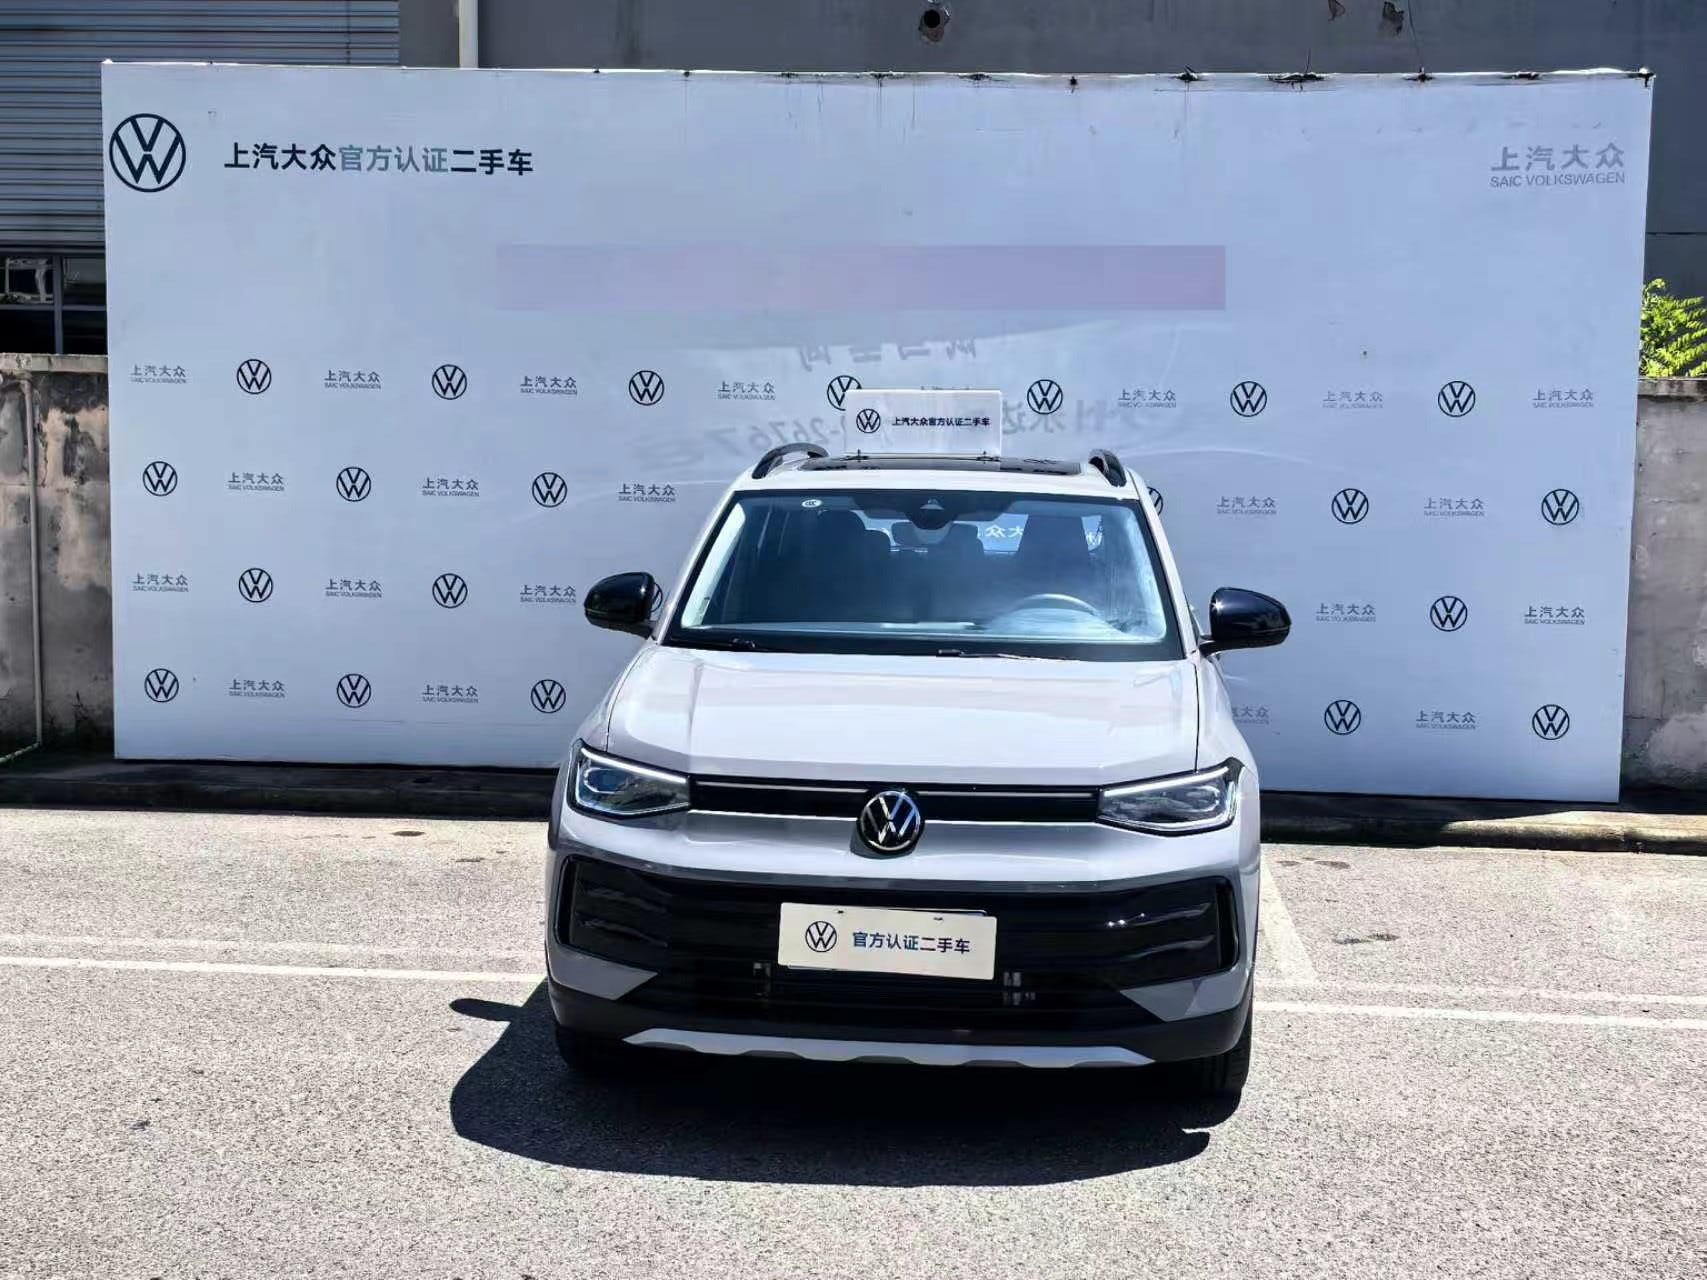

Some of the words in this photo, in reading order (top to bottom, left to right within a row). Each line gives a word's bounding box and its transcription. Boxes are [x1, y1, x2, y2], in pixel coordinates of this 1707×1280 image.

[224, 142, 534, 176] 上汽大众官方认证二手车
[1491, 142, 1625, 171] 上汽大众
[1490, 175, 1522, 188] SAIC
[1526, 171, 1626, 186] VOLKSWAGEN
[131, 364, 186, 377] 上汽大众
[325, 369, 380, 382] 上汽大众
[521, 376, 577, 388] 上汽大众
[718, 381, 776, 393] 上汽大众
[1118, 389, 1177, 401] 上汽大众
[1323, 391, 1383, 402] 上汽大众
[1533, 389, 1592, 401] 上汽大众
[892, 416, 990, 427] 上汽大众官方认证二手车
[228, 472, 284, 485] 上汽大众
[423, 478, 478, 490] 上汽大众
[618, 484, 675, 496] 上汽大众
[1217, 497, 1276, 508] 上汽大众
[1424, 498, 1483, 510] 上汽大众
[132, 574, 188, 586] 上汽大众
[325, 579, 381, 592] 上汽大众
[520, 585, 577, 597] 上汽大众
[1316, 603, 1376, 616] 上汽大众
[1524, 606, 1584, 618] 上汽大众
[229, 679, 285, 691] 上汽大众
[422, 685, 478, 697] 上汽大众
[1416, 711, 1475, 723] 上汽大众
[852, 931, 970, 954] 官方认证二手车
